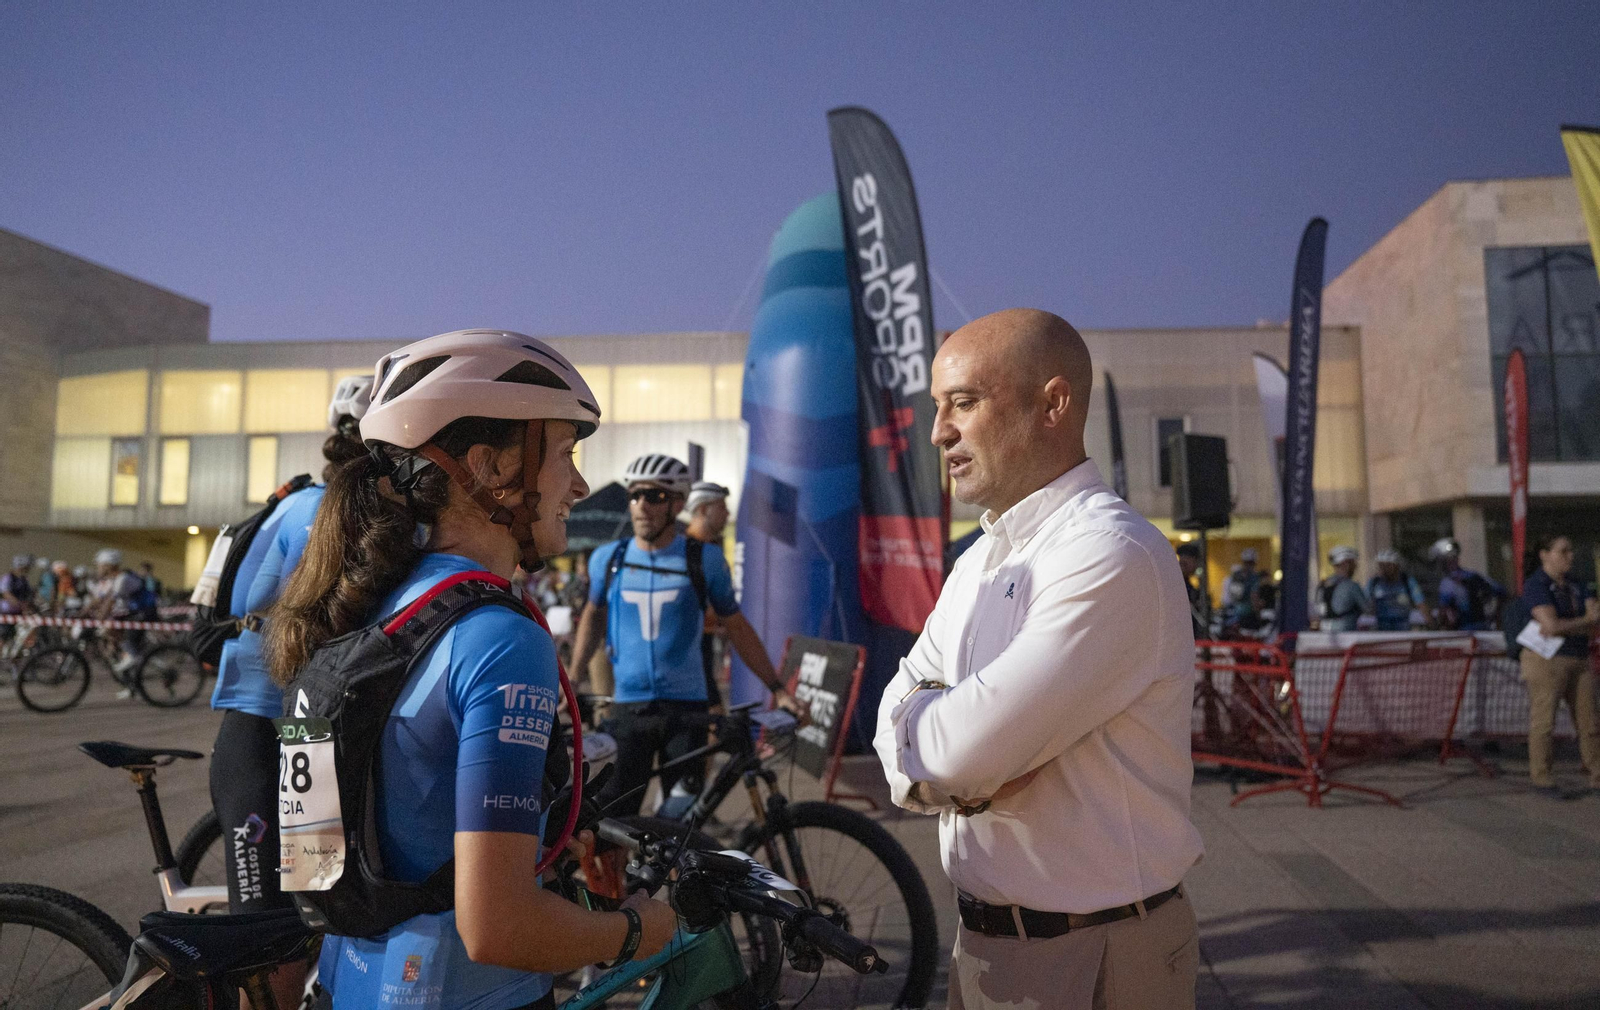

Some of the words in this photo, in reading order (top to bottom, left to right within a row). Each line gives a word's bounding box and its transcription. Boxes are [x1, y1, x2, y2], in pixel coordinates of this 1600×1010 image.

[497, 683, 556, 718] TITAN
[280, 751, 313, 794] 28
[280, 800, 304, 815] CIA
[248, 846, 260, 884] COSTA
[252, 884, 262, 900] DE
